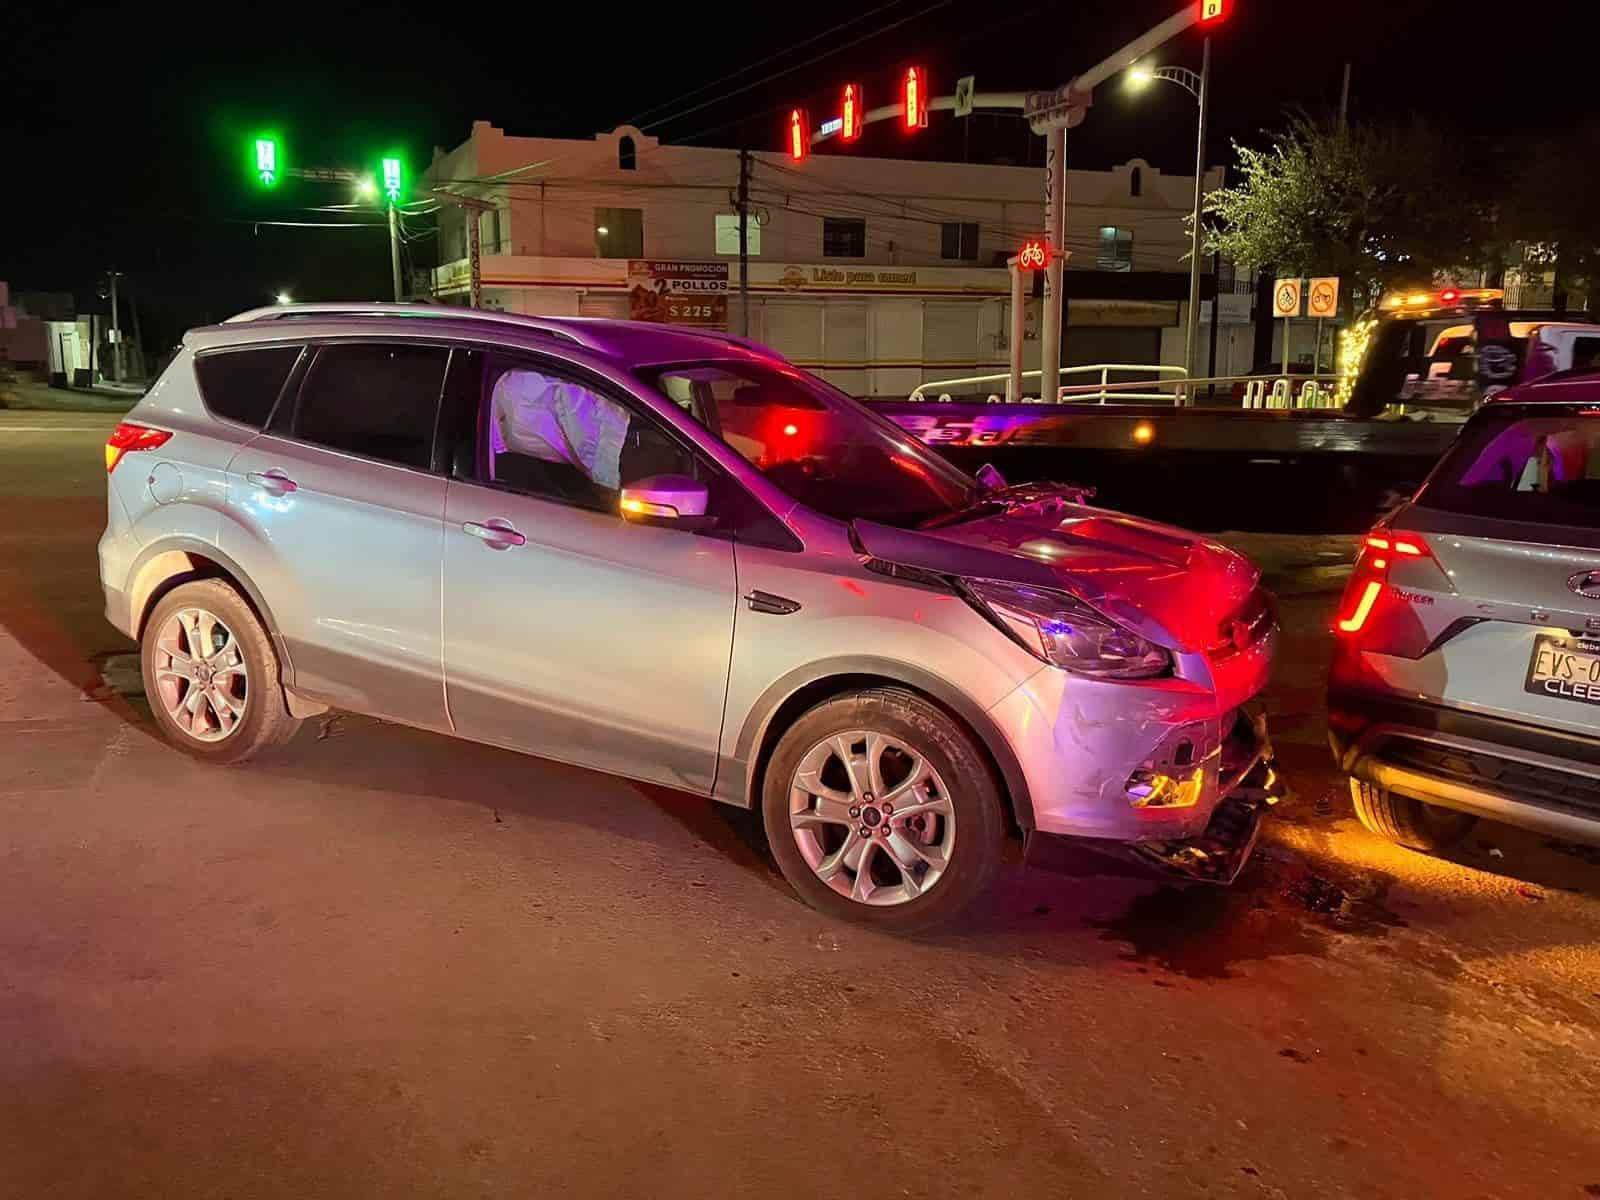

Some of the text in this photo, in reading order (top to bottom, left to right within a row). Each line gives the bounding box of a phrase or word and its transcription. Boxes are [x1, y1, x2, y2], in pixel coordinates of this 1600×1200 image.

[655, 263, 678, 272] GRAN
[654, 278, 728, 296] 2 POLLOS
